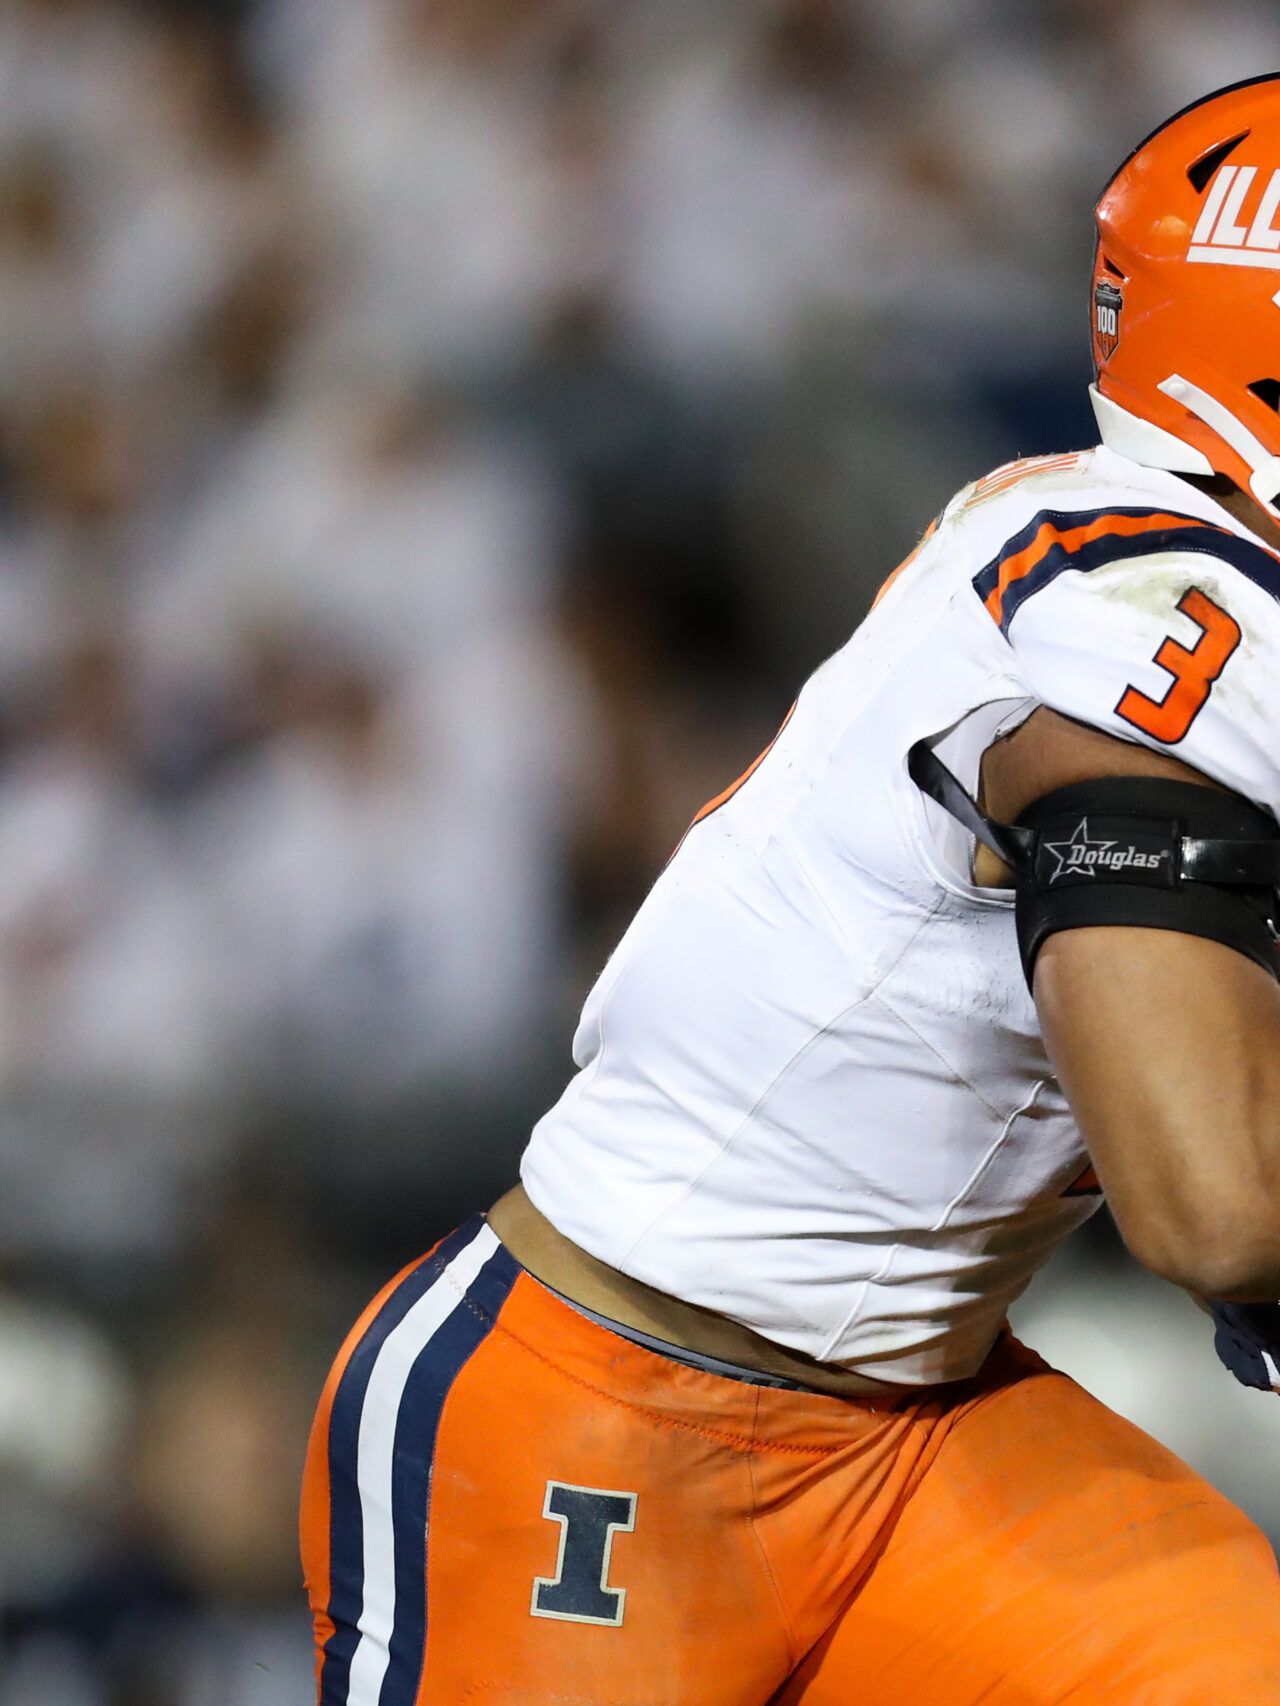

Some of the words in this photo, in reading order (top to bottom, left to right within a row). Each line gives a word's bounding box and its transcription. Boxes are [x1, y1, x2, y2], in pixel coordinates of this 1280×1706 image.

[1096, 304, 1116, 337] 100
[1114, 585, 1242, 744] 3
[530, 1480, 638, 1627] I
